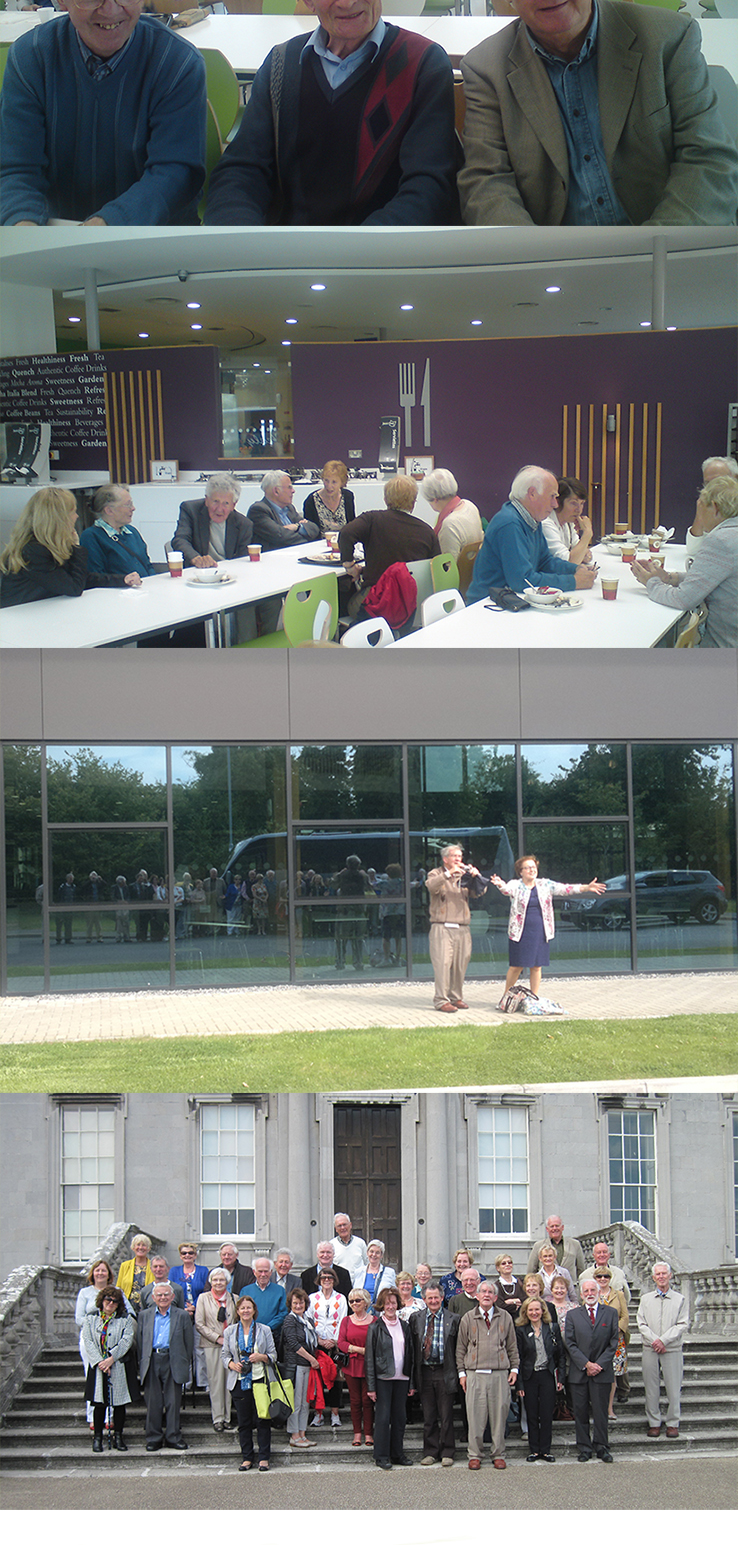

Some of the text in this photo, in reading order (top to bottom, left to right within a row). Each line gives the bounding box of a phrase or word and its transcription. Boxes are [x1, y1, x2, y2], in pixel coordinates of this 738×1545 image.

[16, 358, 29, 366] Fresh
[32, 356, 66, 365] Healthiness
[69, 354, 89, 363] Fresh
[93, 353, 105, 361] Tea
[11, 368, 35, 378] Quench
[37, 367, 63, 375] Authentic
[65, 365, 85, 374] Coffee
[86, 363, 107, 373] Drinks
[45, 377, 75, 385] Sweetness
[78, 375, 105, 384] Garden
[21, 388, 37, 397] Blend
[40, 387, 55, 396] Fresh
[57, 386, 81, 396] Quench
[12, 399, 28, 407] Coffee
[29, 398, 47, 406] Drinks
[49, 397, 83, 406] Sweetness
[24, 409, 41, 417] Beans
[44, 408, 54, 416] Tea
[56, 407, 94, 418] Sustainability
[75, 418, 104, 427] Beverages
[70, 429, 89, 437] Coffee
[81, 439, 107, 448] Garden
